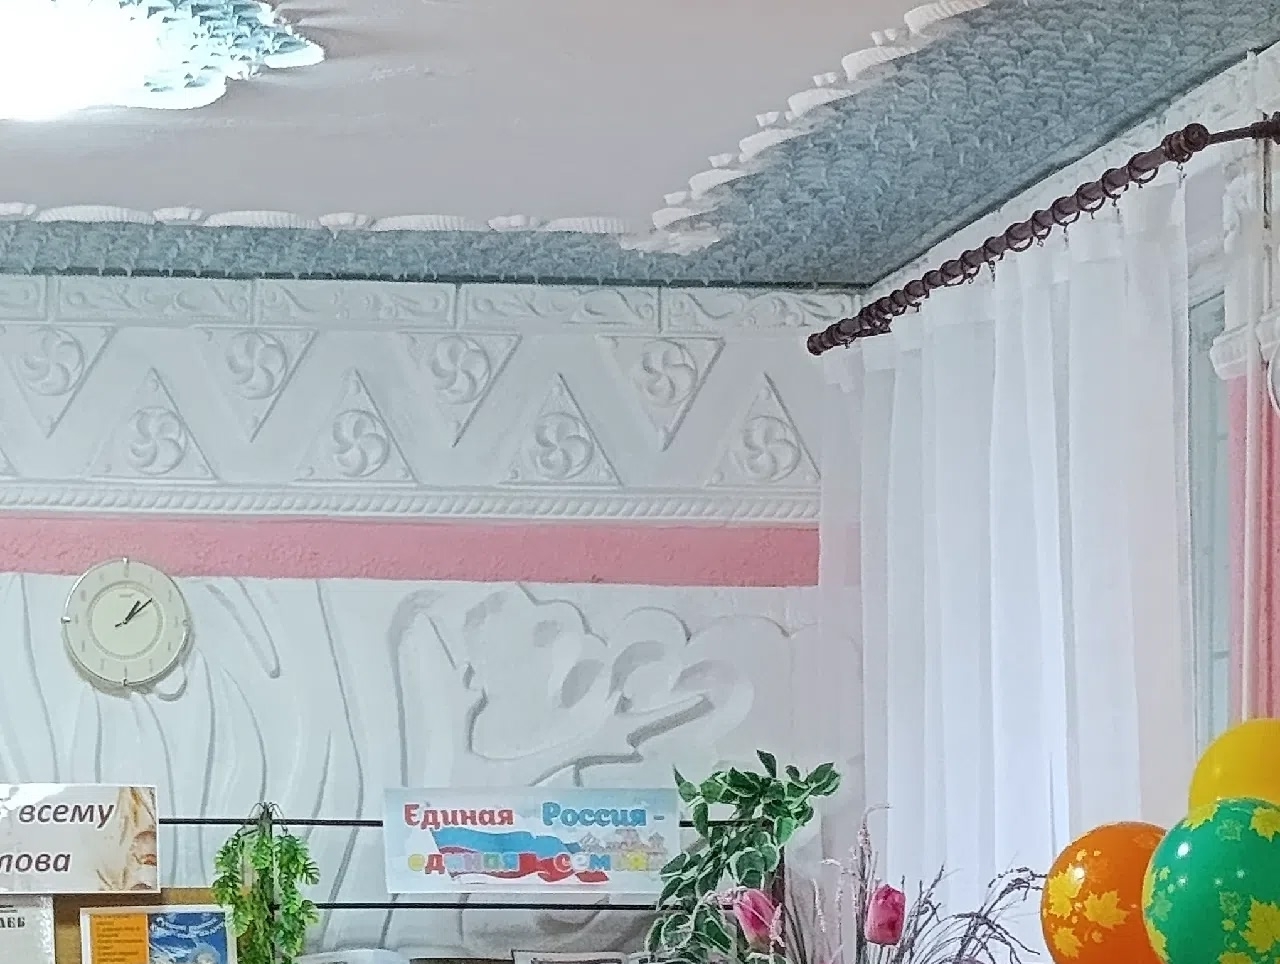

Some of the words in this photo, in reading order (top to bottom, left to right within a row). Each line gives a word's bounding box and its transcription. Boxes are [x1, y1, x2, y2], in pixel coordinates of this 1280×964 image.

[20, 803, 114, 828] всему
[404, 803, 514, 829] Единая
[542, 802, 647, 827] Россия
